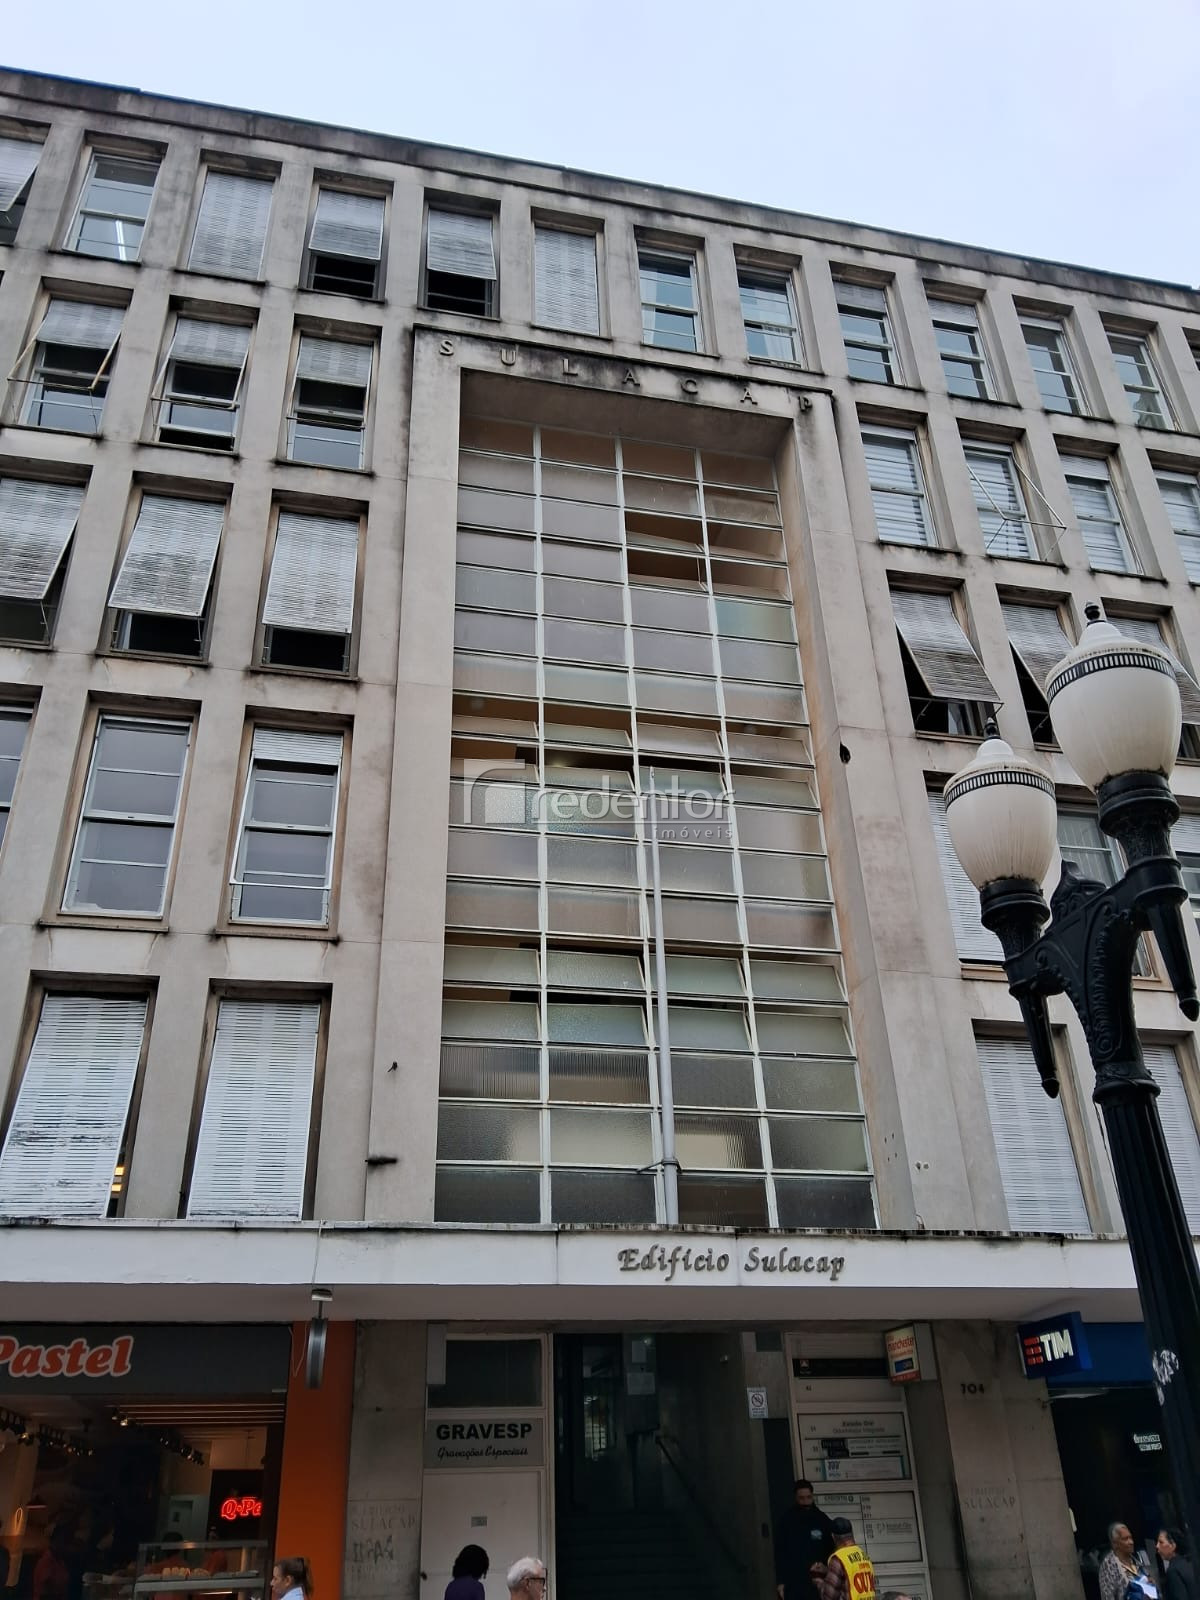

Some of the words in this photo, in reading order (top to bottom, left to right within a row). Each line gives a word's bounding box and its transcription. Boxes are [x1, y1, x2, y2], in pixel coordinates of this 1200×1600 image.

[439, 338, 813, 412] SULACAP
[617, 1244, 730, 1282] Edifício
[744, 1246, 845, 1281] Sulacap
[1040, 1329, 1074, 1362] TIM
[436, 1423, 533, 1440] GRAVESP
